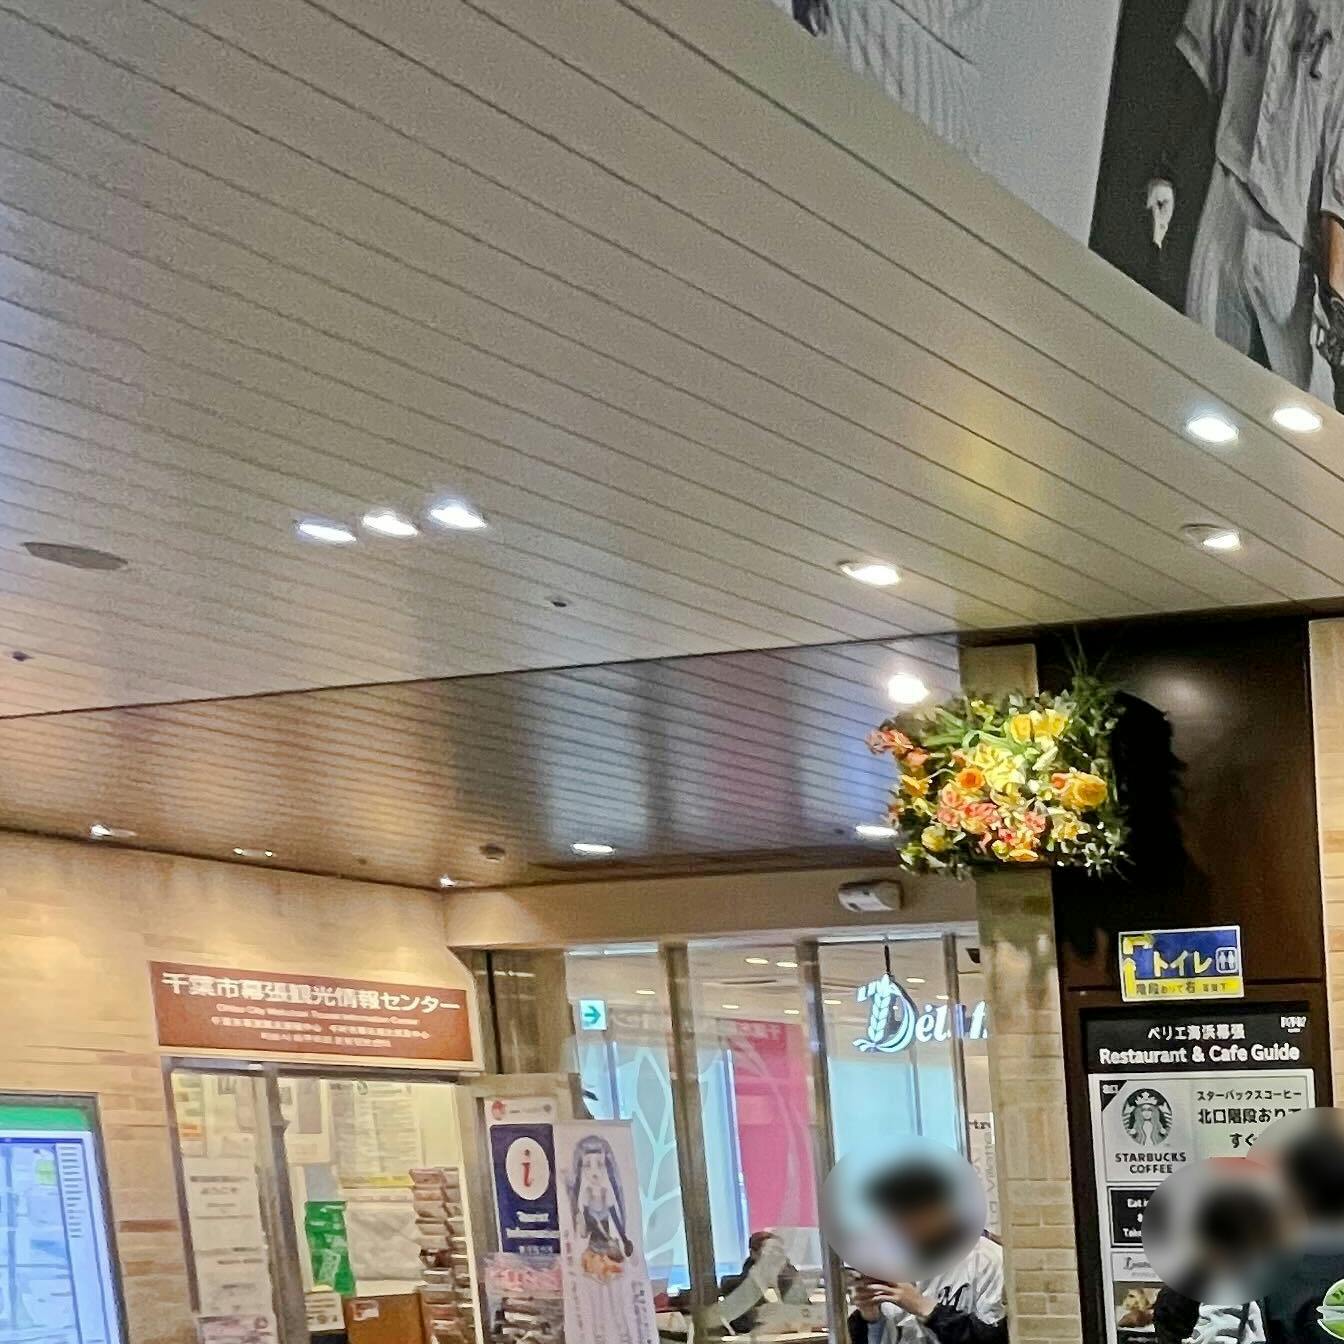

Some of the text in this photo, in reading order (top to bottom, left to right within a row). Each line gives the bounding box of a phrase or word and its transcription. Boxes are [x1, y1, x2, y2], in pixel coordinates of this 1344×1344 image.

[1153, 949, 1213, 978] トイレ
[1099, 1042, 1301, 1065] Restaurant & Cafe Guide
[1198, 1108, 1301, 1125] 北口階段おり
[1114, 1152, 1187, 1163] STARBUCKS
[1129, 1164, 1173, 1174] COFFEE
